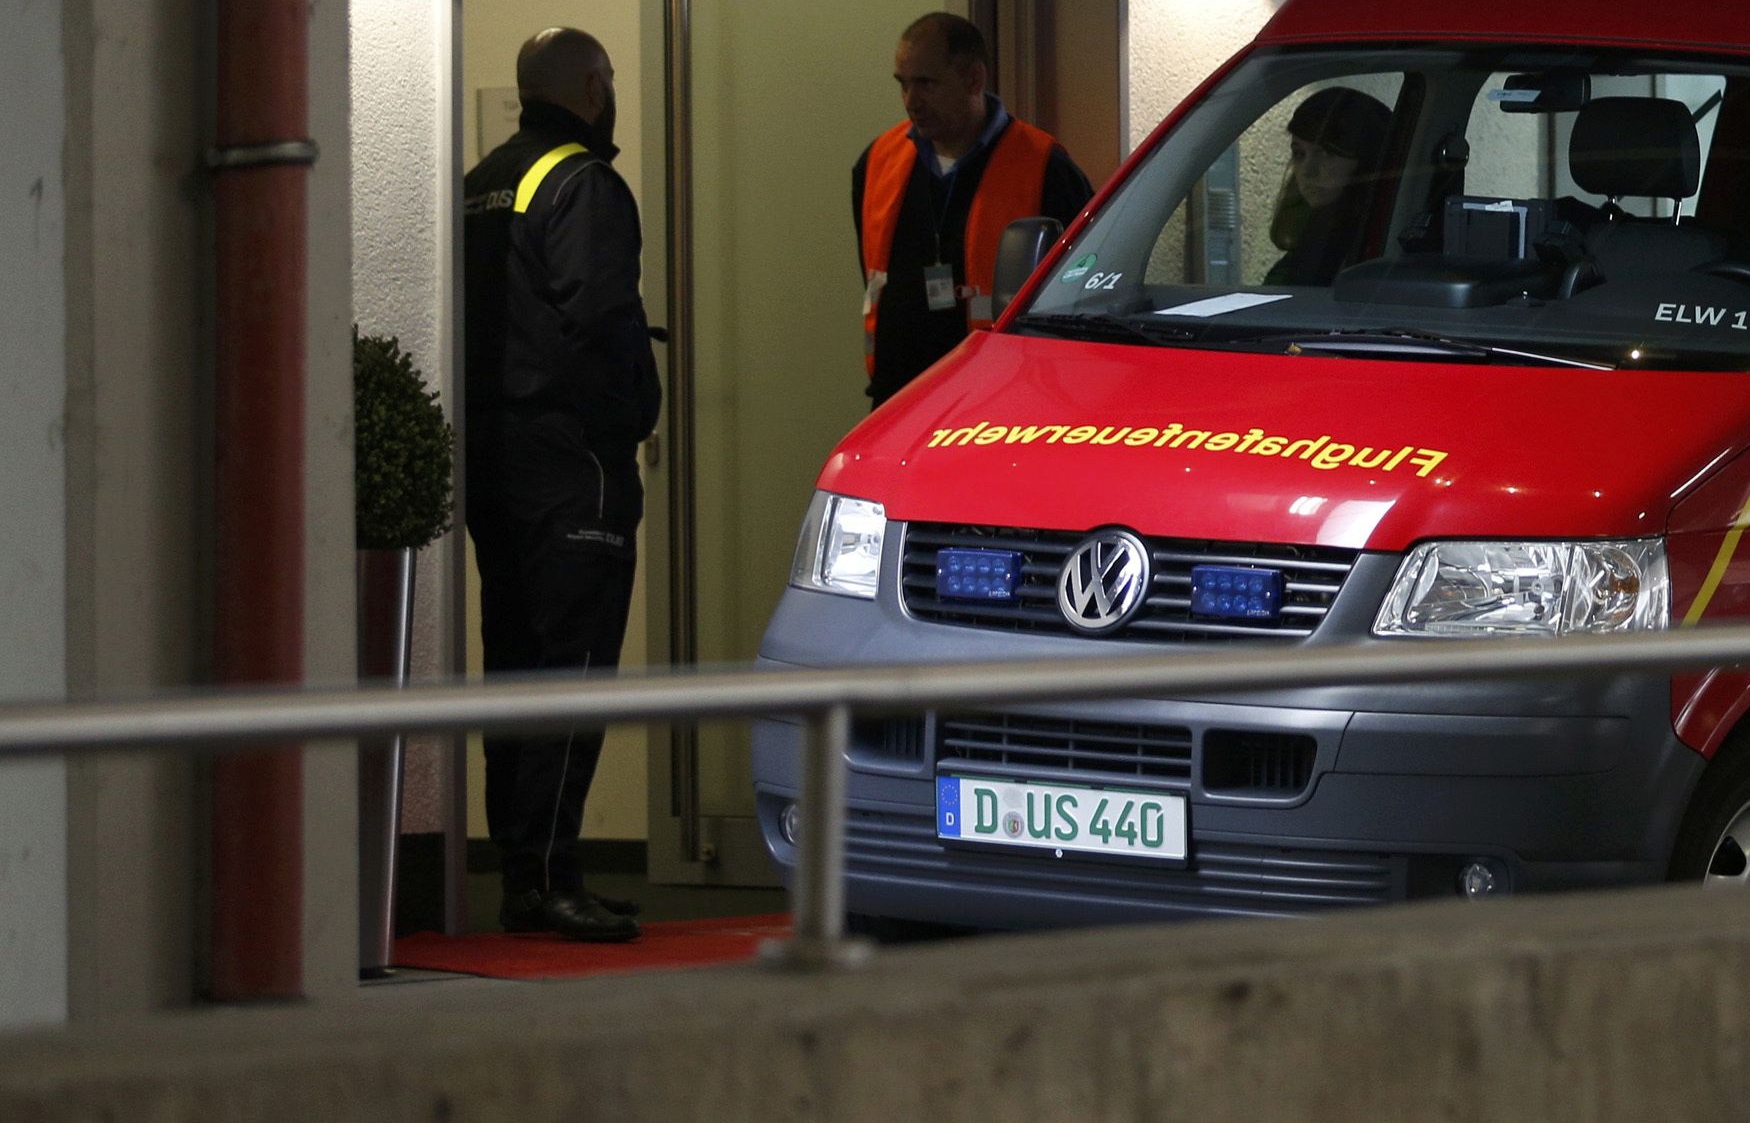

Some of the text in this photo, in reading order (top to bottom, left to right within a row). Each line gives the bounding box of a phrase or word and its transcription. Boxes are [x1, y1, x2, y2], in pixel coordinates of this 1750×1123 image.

[1084, 272, 1123, 290] 6/1
[1654, 303, 1748, 330] ELW 1
[974, 788, 1164, 848] D US 440
